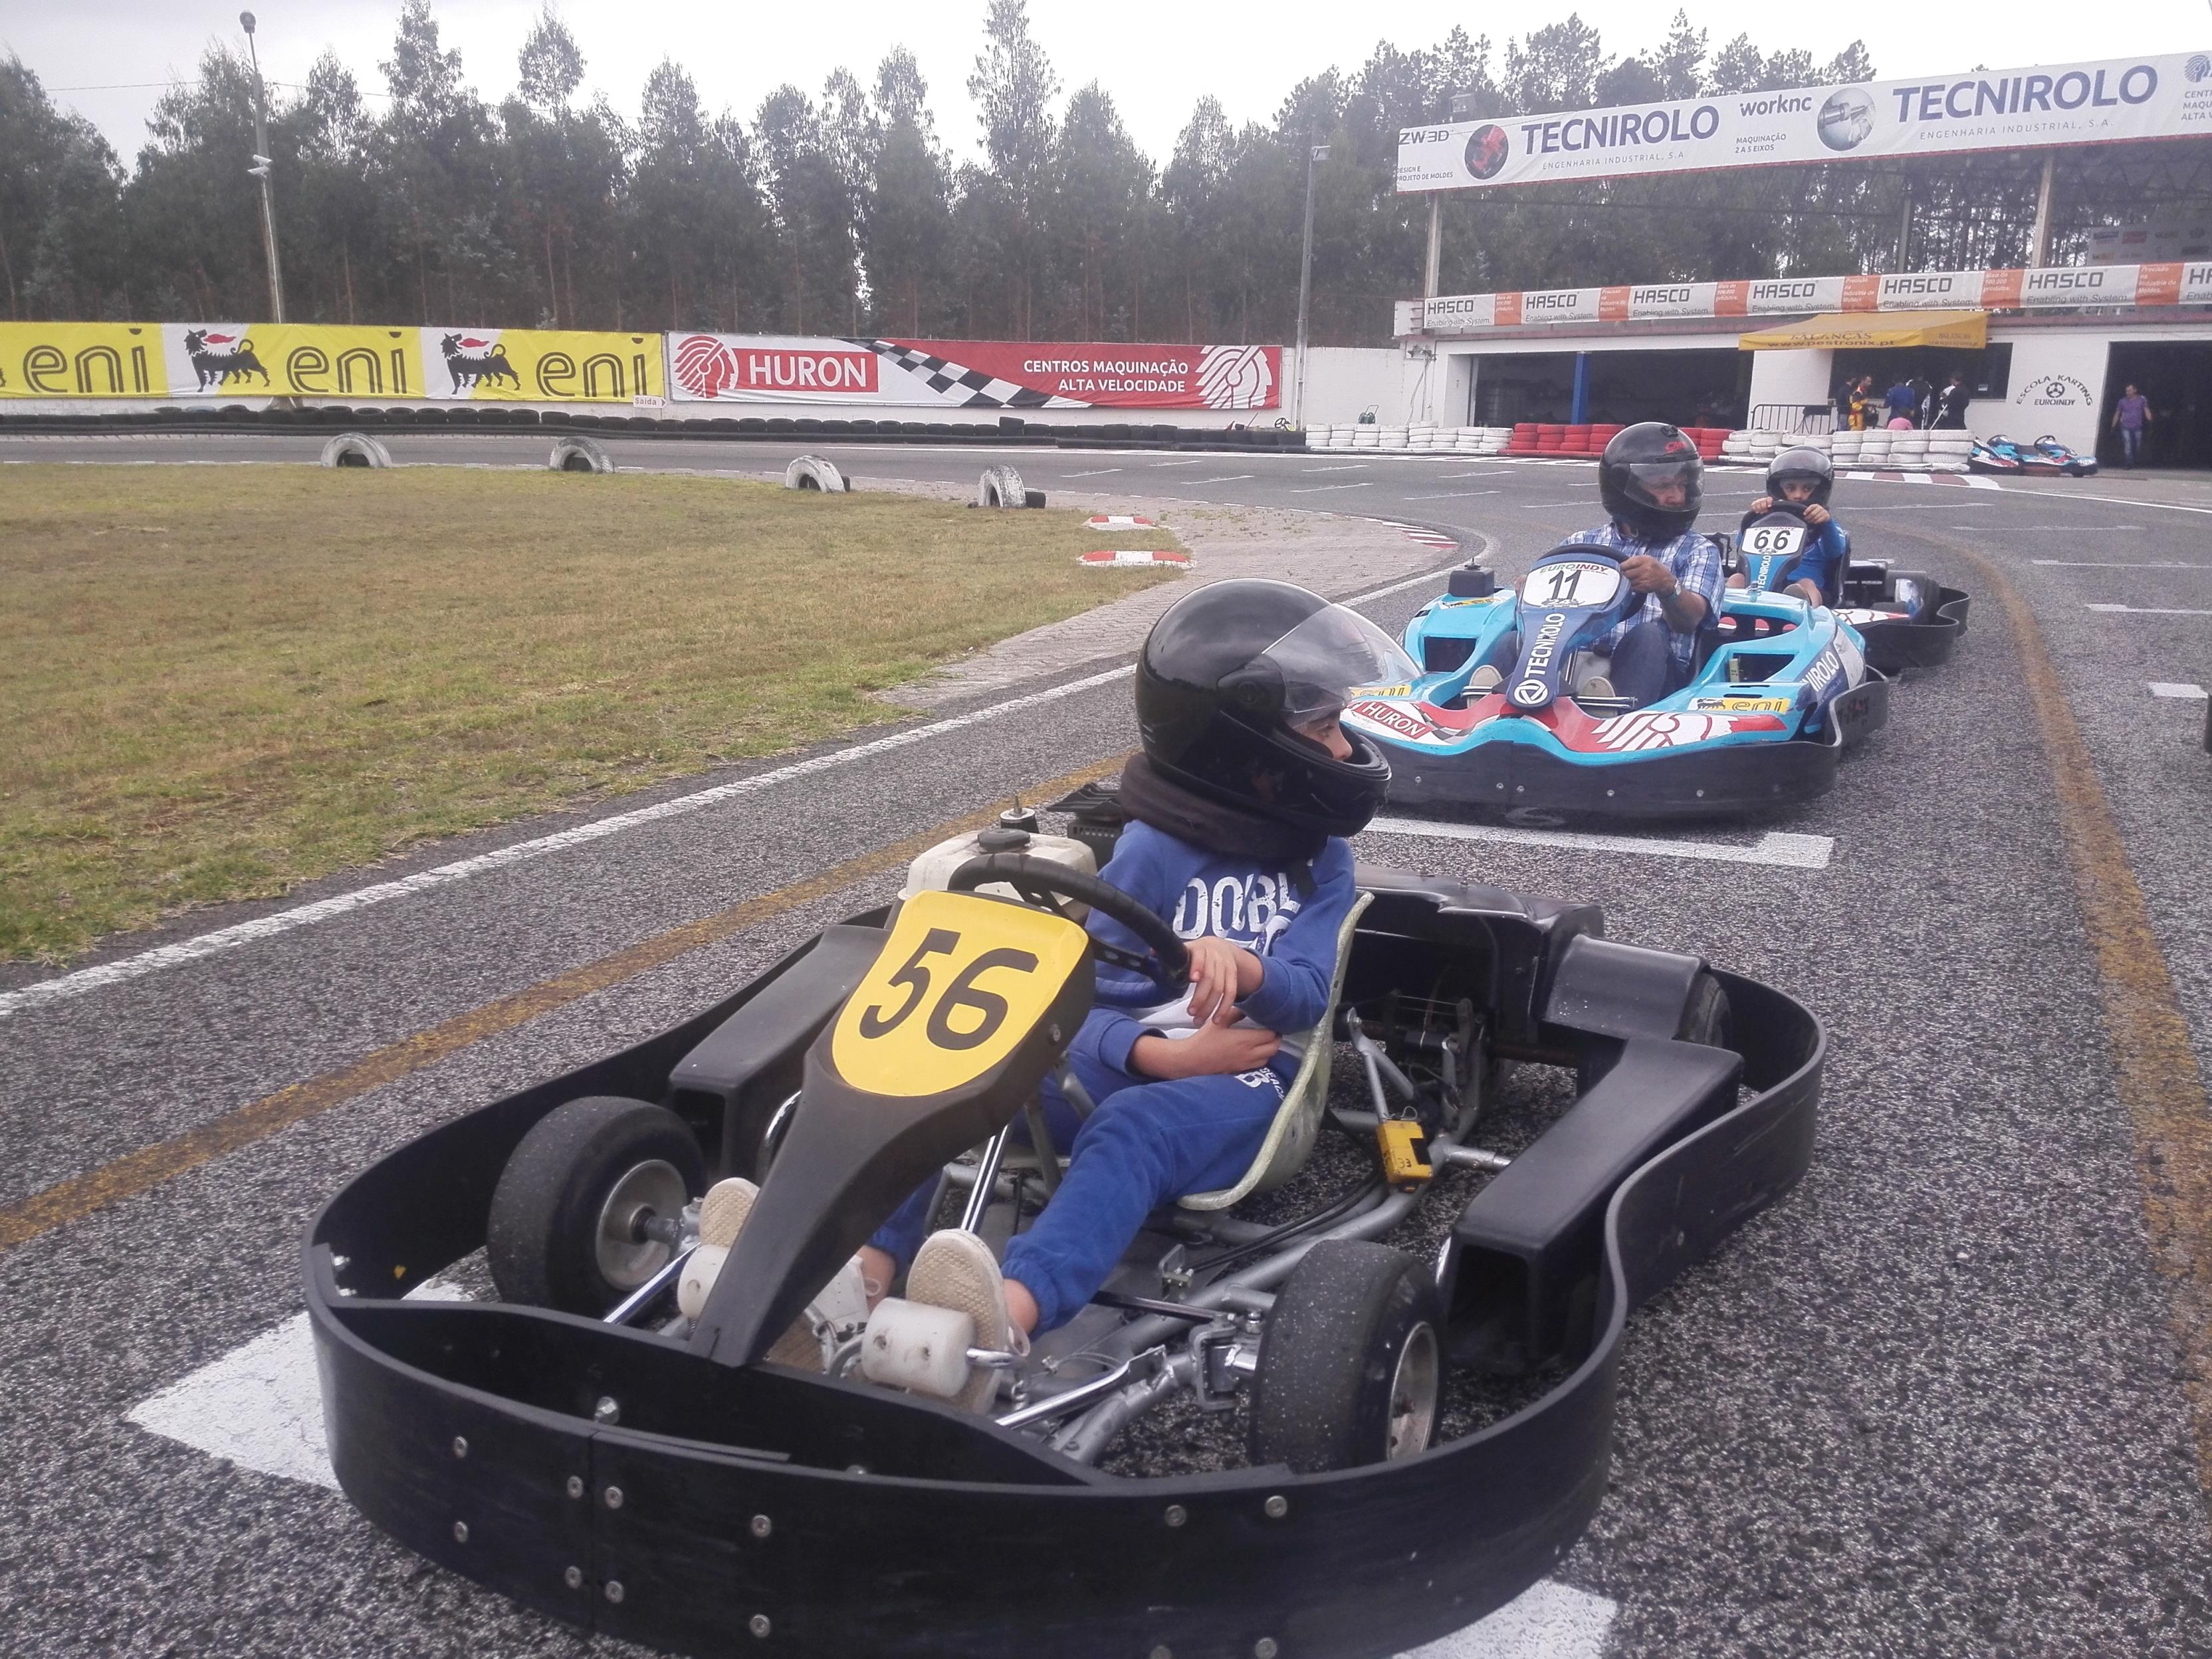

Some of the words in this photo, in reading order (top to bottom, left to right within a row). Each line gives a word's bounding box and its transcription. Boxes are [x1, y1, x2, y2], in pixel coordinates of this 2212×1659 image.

[1893, 64, 2158, 122] TECNIROLO
[1739, 94, 1812, 116] worknc
[2181, 112, 2205, 120] ALTA
[1521, 105, 1719, 154] TECNIROLO
[1920, 127, 1996, 140] ENGENHARIA
[1736, 133, 1786, 144] MAQUINAÇÃO
[1543, 159, 1601, 169] ENGENHARIA
[1884, 278, 1952, 294] HASCO
[2028, 272, 2104, 289] HASCO
[1633, 288, 1690, 304] HASCO
[1753, 283, 1815, 298] HASCO
[1428, 300, 1474, 314] HASCO
[1526, 294, 1577, 309] HASCO
[23, 328, 150, 393] eni
[286, 331, 407, 393] eni
[536, 337, 647, 397] eni
[1024, 360, 1089, 372] CENTROS
[1093, 359, 1188, 376] MAQUINAÇÃO
[749, 355, 866, 387] HURON
[1059, 379, 1095, 391] ALTA
[1099, 379, 1185, 392] VELOCIDADE
[2016, 376, 2050, 405] ESCOLA
[2057, 375, 2093, 406] KARTING
[1754, 530, 1791, 550] 66
[1539, 564, 1608, 574] EUROINDY
[1549, 570, 1582, 600] 11
[1524, 613, 1565, 679] TECNIROLO
[1732, 697, 1783, 712] eni
[1362, 702, 1426, 736] HURON
[859, 928, 1040, 1051] 56
